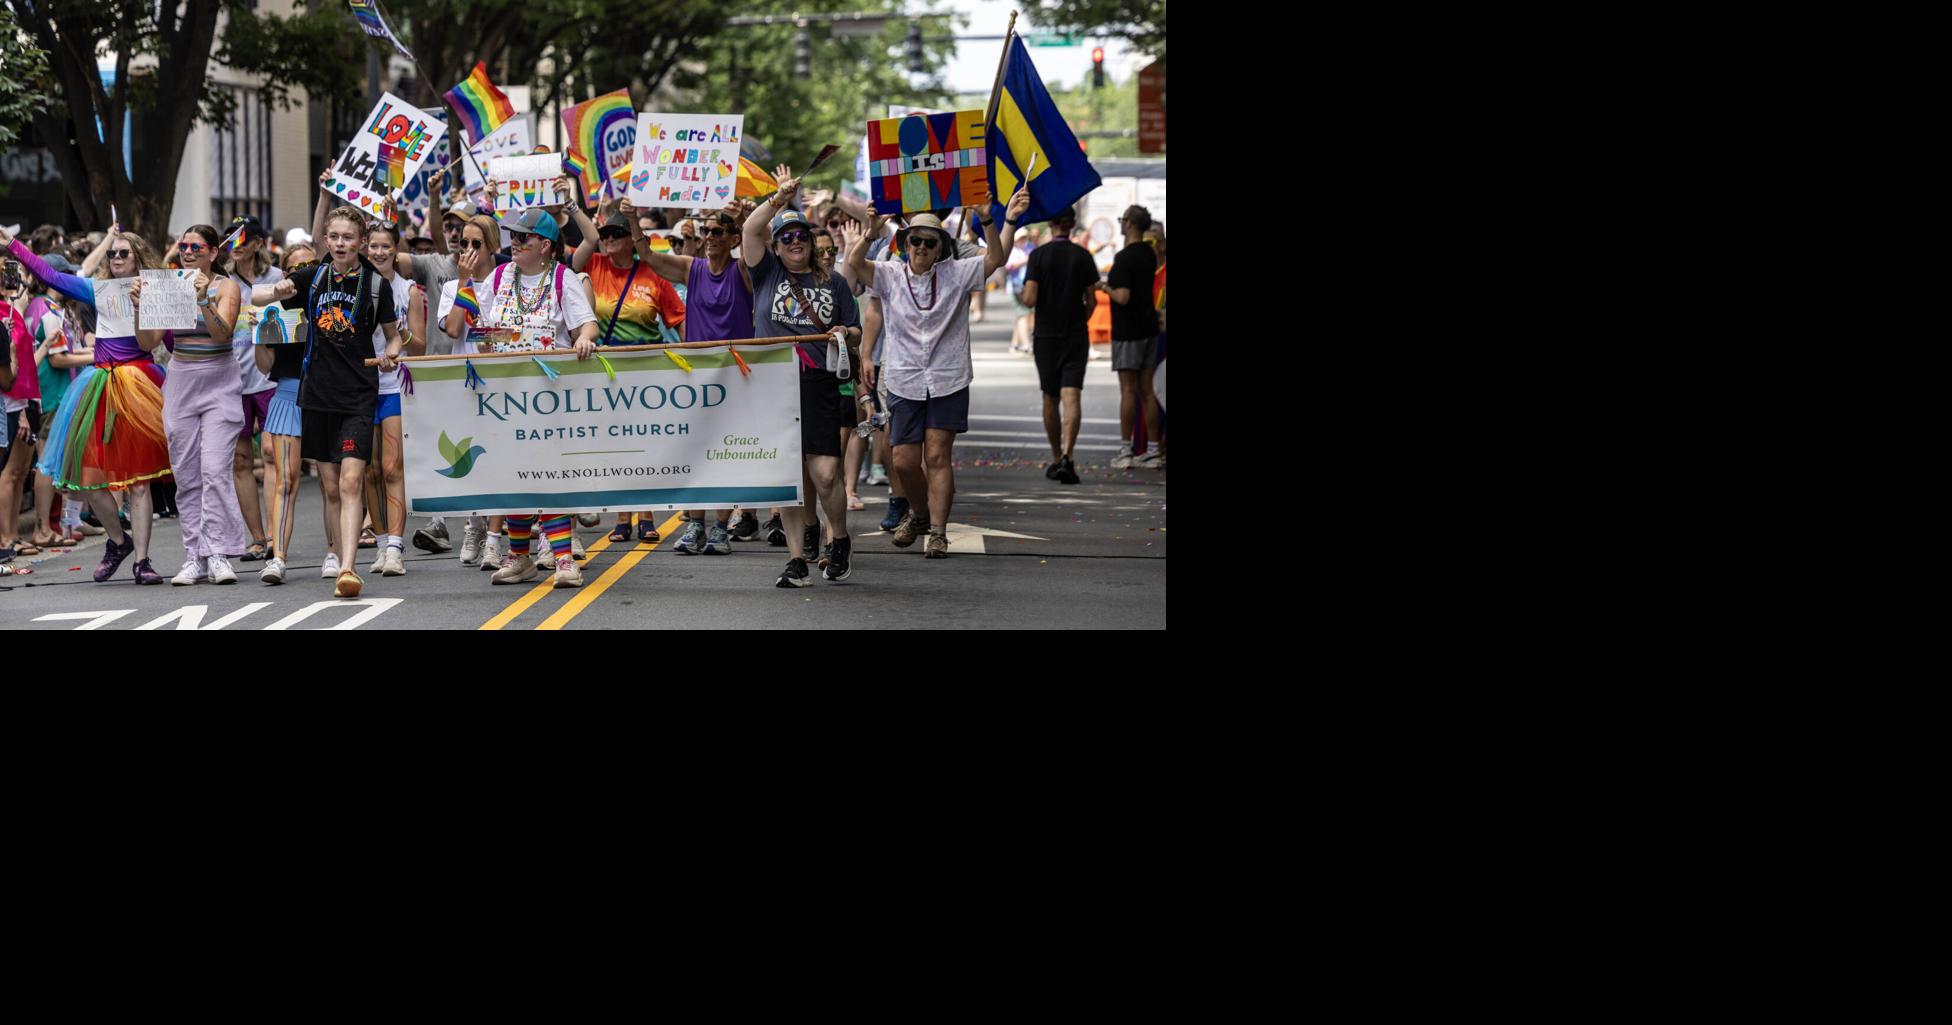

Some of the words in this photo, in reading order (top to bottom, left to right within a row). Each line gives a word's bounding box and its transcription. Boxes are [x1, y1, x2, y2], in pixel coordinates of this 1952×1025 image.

[368, 102, 433, 162] LOVE
[606, 126, 636, 152] GOD
[649, 122, 667, 140] We
[675, 128, 706, 142] are
[710, 123, 738, 143] ALL
[867, 110, 984, 160] LOVE
[643, 144, 721, 164] WONDER
[912, 152, 945, 171] IS
[656, 166, 710, 181] FULLY
[871, 166, 988, 215] LOVE
[777, 280, 833, 304] GD'S
[476, 383, 727, 421] KNOLLWOOD
[515, 425, 598, 440] BAPTIST
[608, 423, 689, 437] CHURCH
[723, 434, 760, 446] Grace
[706, 447, 777, 460] Unbounded
[517, 464, 691, 480] WWW.KNOLLWOOD.ORG
